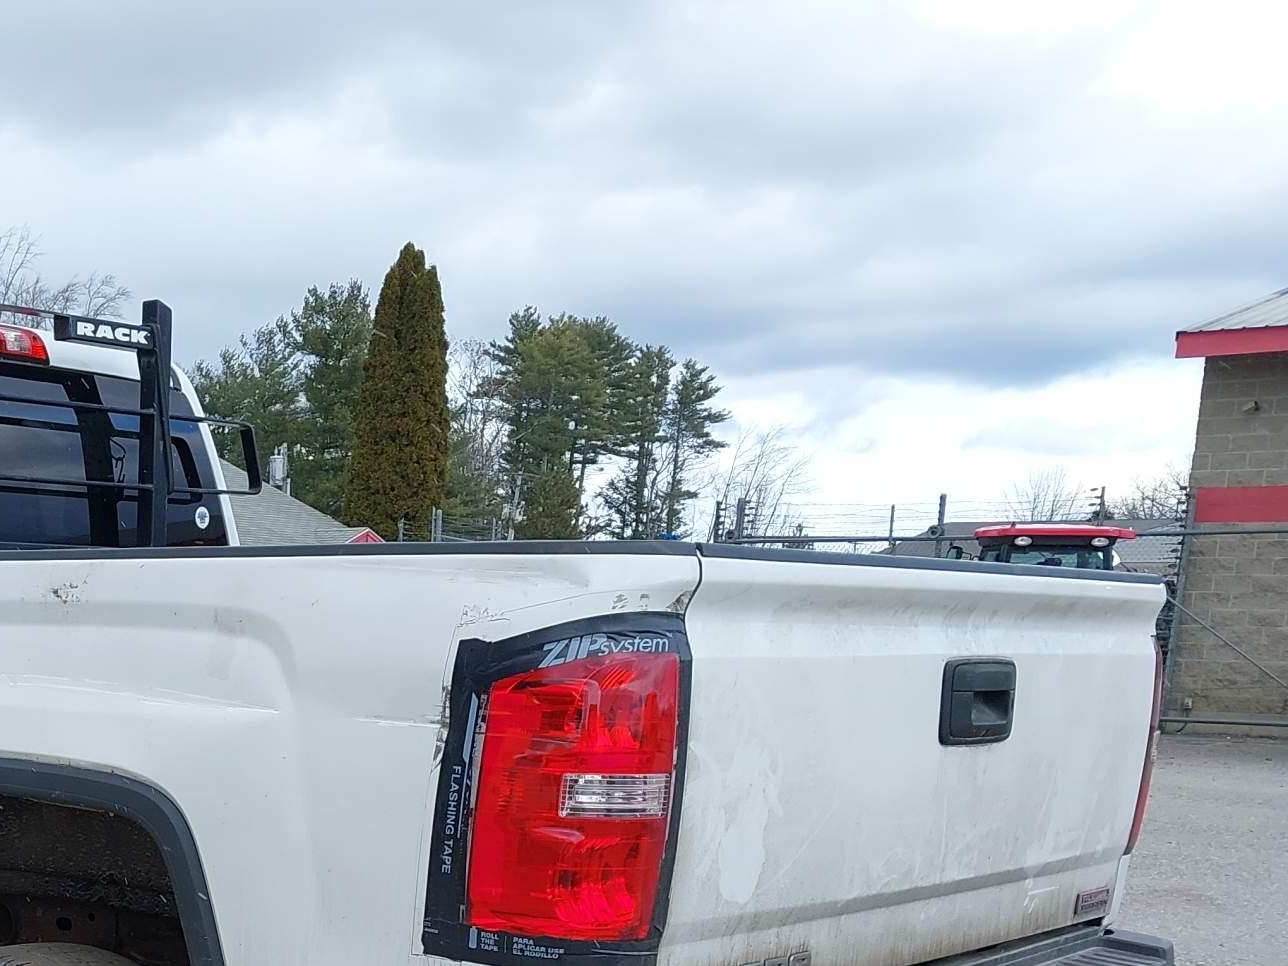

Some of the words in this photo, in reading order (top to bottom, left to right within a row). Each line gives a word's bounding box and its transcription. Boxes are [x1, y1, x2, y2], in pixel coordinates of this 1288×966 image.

[76, 321, 150, 345] RACK
[445, 765, 462, 835] FLASHING
[441, 838, 454, 874] TAPE
[480, 931, 499, 940] ROLL
[512, 936, 534, 945] PARA
[480, 943, 499, 952] TAPE
[512, 943, 546, 953] APLICAR
[524, 949, 559, 959] RODILLO
